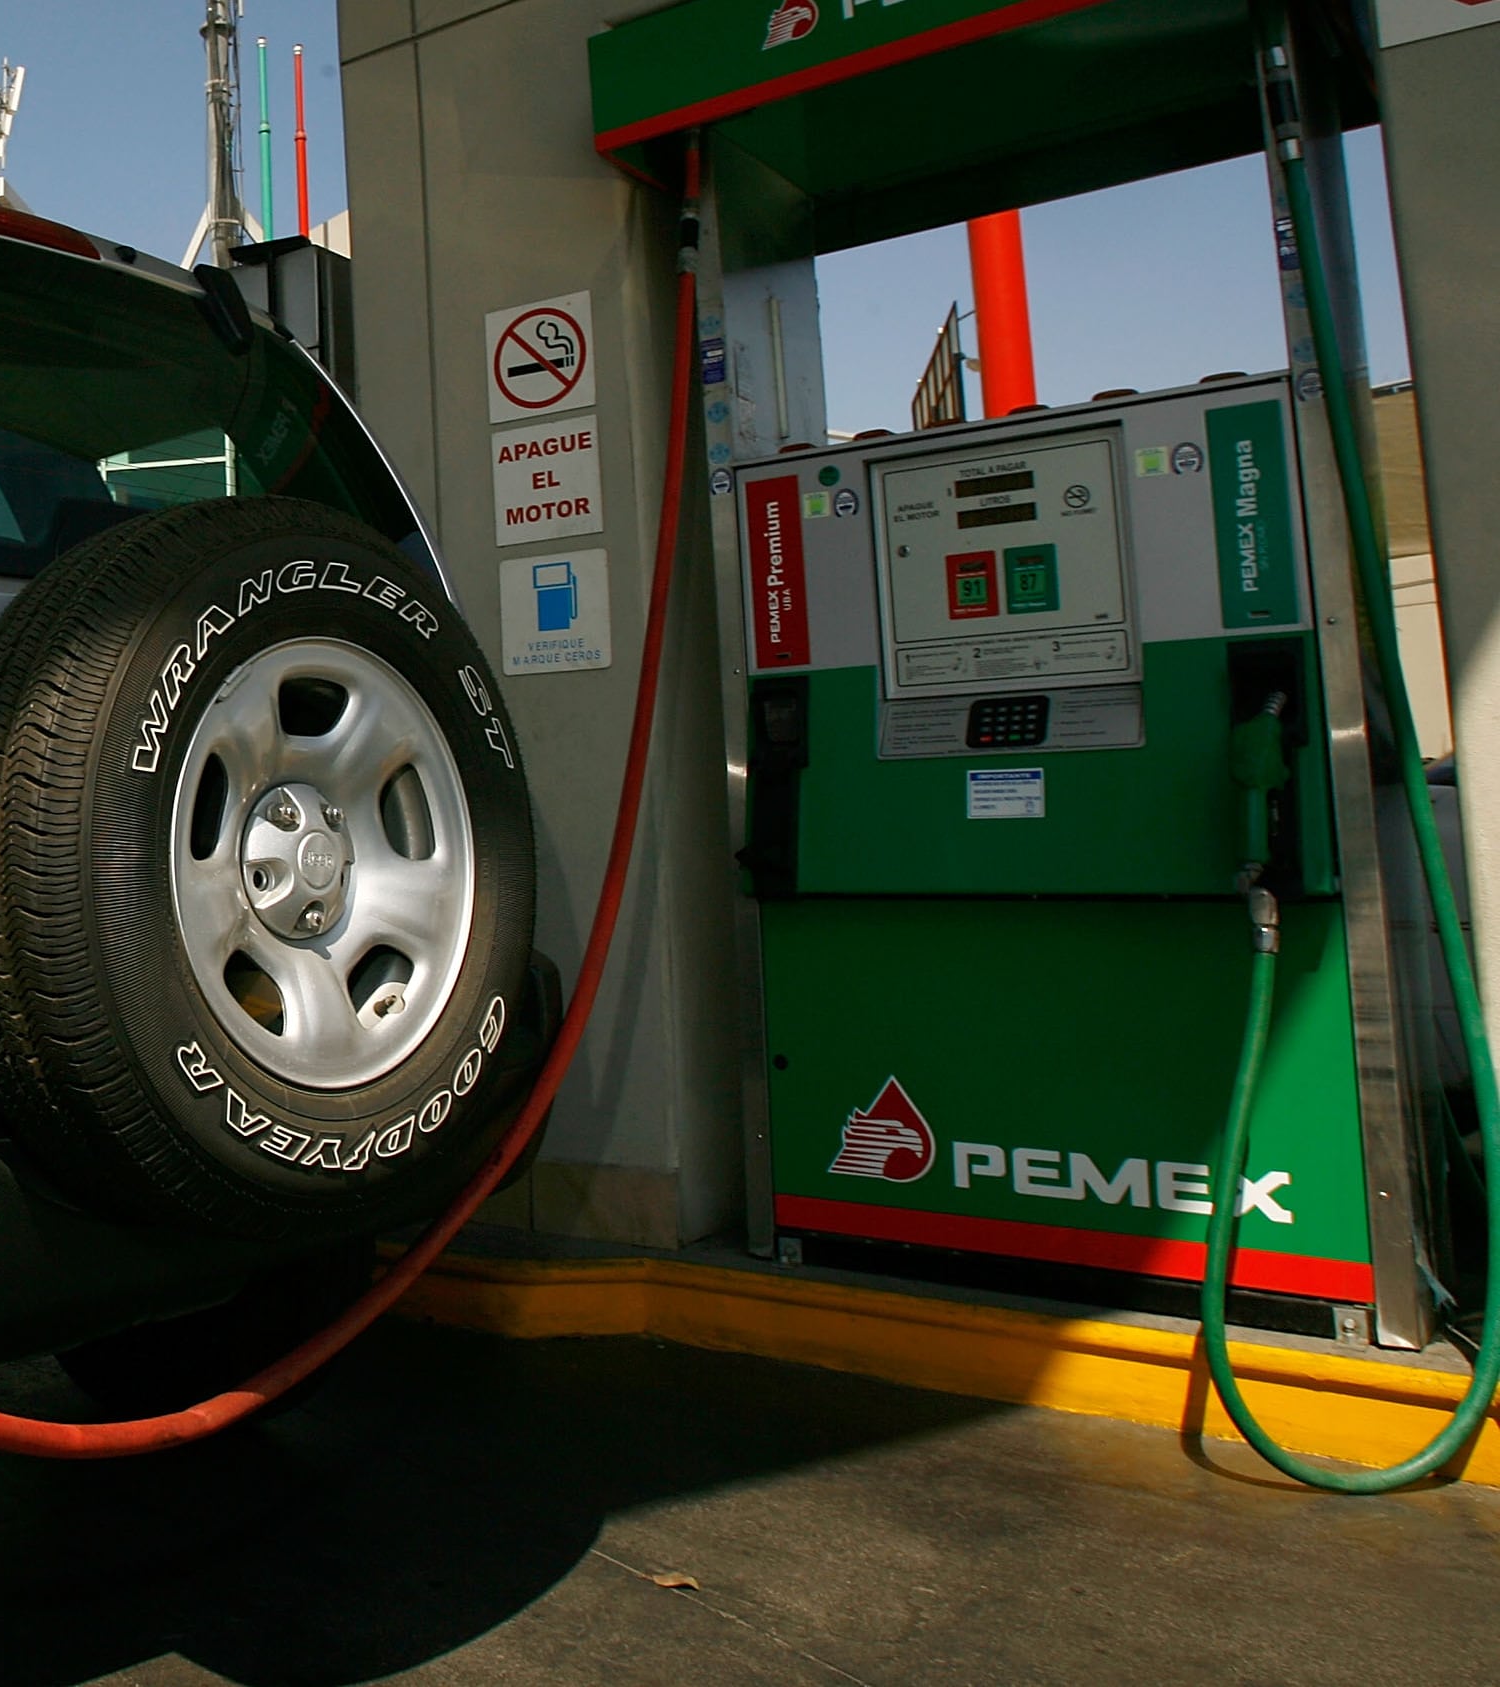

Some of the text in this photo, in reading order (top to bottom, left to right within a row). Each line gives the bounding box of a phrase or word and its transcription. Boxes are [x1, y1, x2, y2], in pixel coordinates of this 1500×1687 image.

[498, 431, 593, 464] APAGUE
[531, 470, 561, 490] EL
[506, 497, 591, 526] MOTOR
[1236, 439, 1261, 592] PEMEX Magna
[764, 501, 785, 644] PEMEX Premium
[963, 579, 981, 597] 91
[1019, 573, 1037, 591] 87
[528, 637, 585, 651] VERIFIQUE
[564, 649, 602, 662] CEROS
[132, 560, 439, 774] WRANGLER
[458, 664, 514, 770] ST
[176, 996, 506, 1171] GOODYEAR
[952, 1141, 1294, 1225] PEMEX
